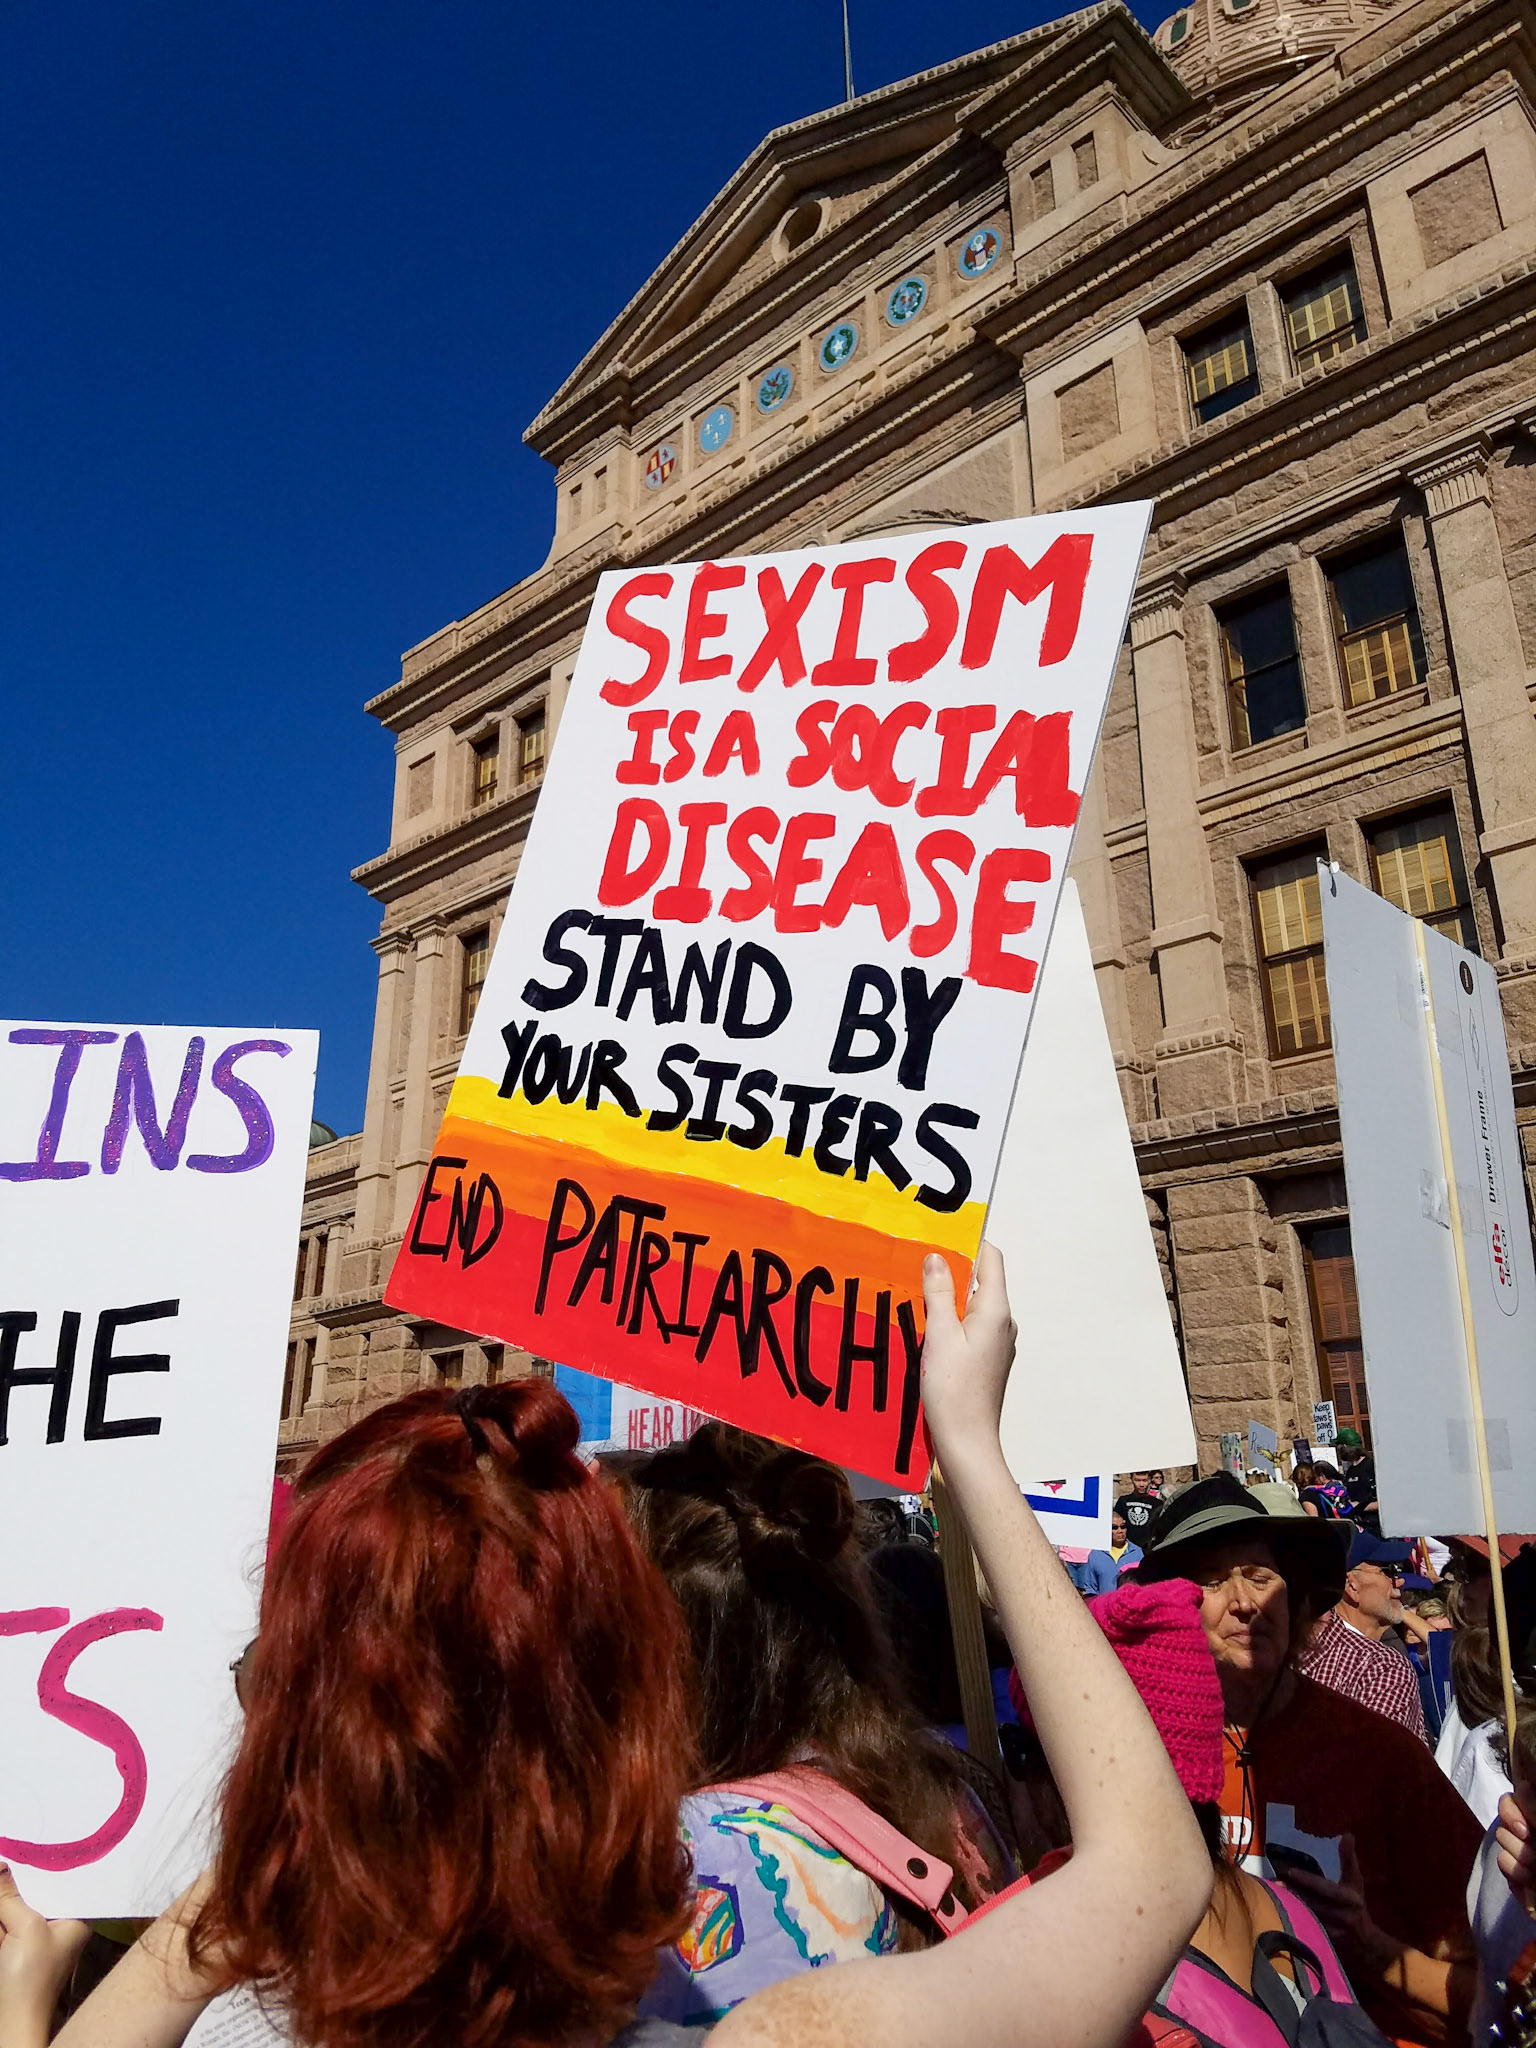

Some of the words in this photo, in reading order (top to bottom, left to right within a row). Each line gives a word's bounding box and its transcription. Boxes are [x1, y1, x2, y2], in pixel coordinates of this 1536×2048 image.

[600, 534, 1093, 706] SEXISM
[616, 709, 701, 785] IS
[703, 710, 760, 777] A
[787, 700, 1081, 827] SOCIAL
[598, 798, 1051, 993] DISEASE
[521, 910, 793, 1039] STAND
[827, 964, 963, 1091] BY
[0, 1028, 293, 1182] INS
[498, 1020, 641, 1117] YOUR
[647, 1044, 980, 1212] SISTERS
[1477, 1090, 1489, 1140] Frame
[1484, 1145, 1497, 1203] Drawer
[1492, 1223, 1505, 1285] elfa
[410, 1156, 503, 1269] END
[535, 1178, 925, 1474] PATRIARCHY
[628, 1406, 674, 1451] HEAR
[1314, 1403, 1330, 1412] Keep
[1314, 1414, 1327, 1422] laws
[1316, 1422, 1333, 1432] paws
[1316, 1433, 1326, 1442] off
[0, 1607, 163, 1871] S
